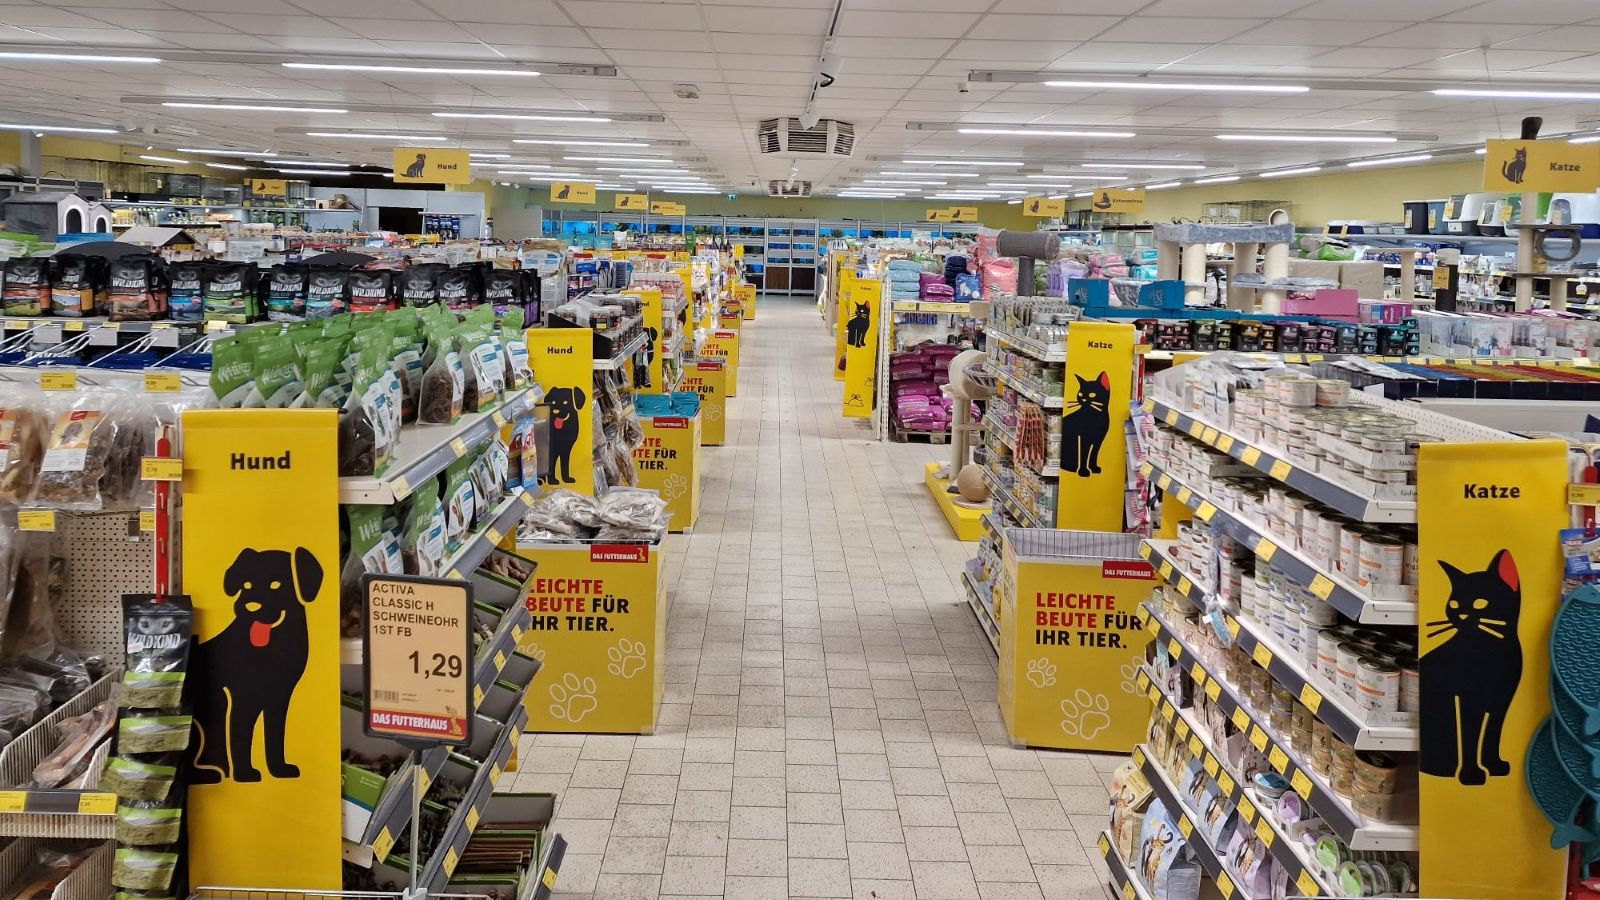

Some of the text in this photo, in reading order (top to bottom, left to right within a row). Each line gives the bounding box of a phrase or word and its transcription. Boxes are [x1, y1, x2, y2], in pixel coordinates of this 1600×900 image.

[437, 162, 457, 170] Hund
[1549, 161, 1581, 172] Katze
[270, 281, 303, 292] WILDKIND
[309, 284, 343, 295] WILDKIND
[352, 286, 386, 297] WILDKIND
[403, 289, 435, 299] WILDKIND
[547, 345, 573, 354] Hund
[1087, 340, 1113, 350] Katze
[697, 385, 714, 393] FÜR
[654, 447, 677, 459] FÜR
[231, 450, 291, 470] Hund
[638, 460, 668, 471] TIER.
[1464, 483, 1521, 499] Katze
[603, 553, 638, 561] FUTTERHAUS
[1116, 569, 1151, 577] FUTTERHAUS
[372, 583, 415, 596] ACTIVA
[529, 578, 604, 595] EICHTE
[372, 597, 434, 611] CLASSIC H
[525, 594, 630, 614] BEUTE FÜR
[1036, 592, 1116, 611] LEICHTE
[372, 611, 459, 628] SCHWEINEOHR
[527, 615, 615, 632] HR TIER.
[1036, 611, 1143, 631] BEUTE FÜR
[373, 625, 412, 637] 1ST FB
[1035, 629, 1128, 649] IHR TIER.
[408, 650, 463, 680] 1,29
[372, 712, 448, 731] DAS FUTTERHAUS
